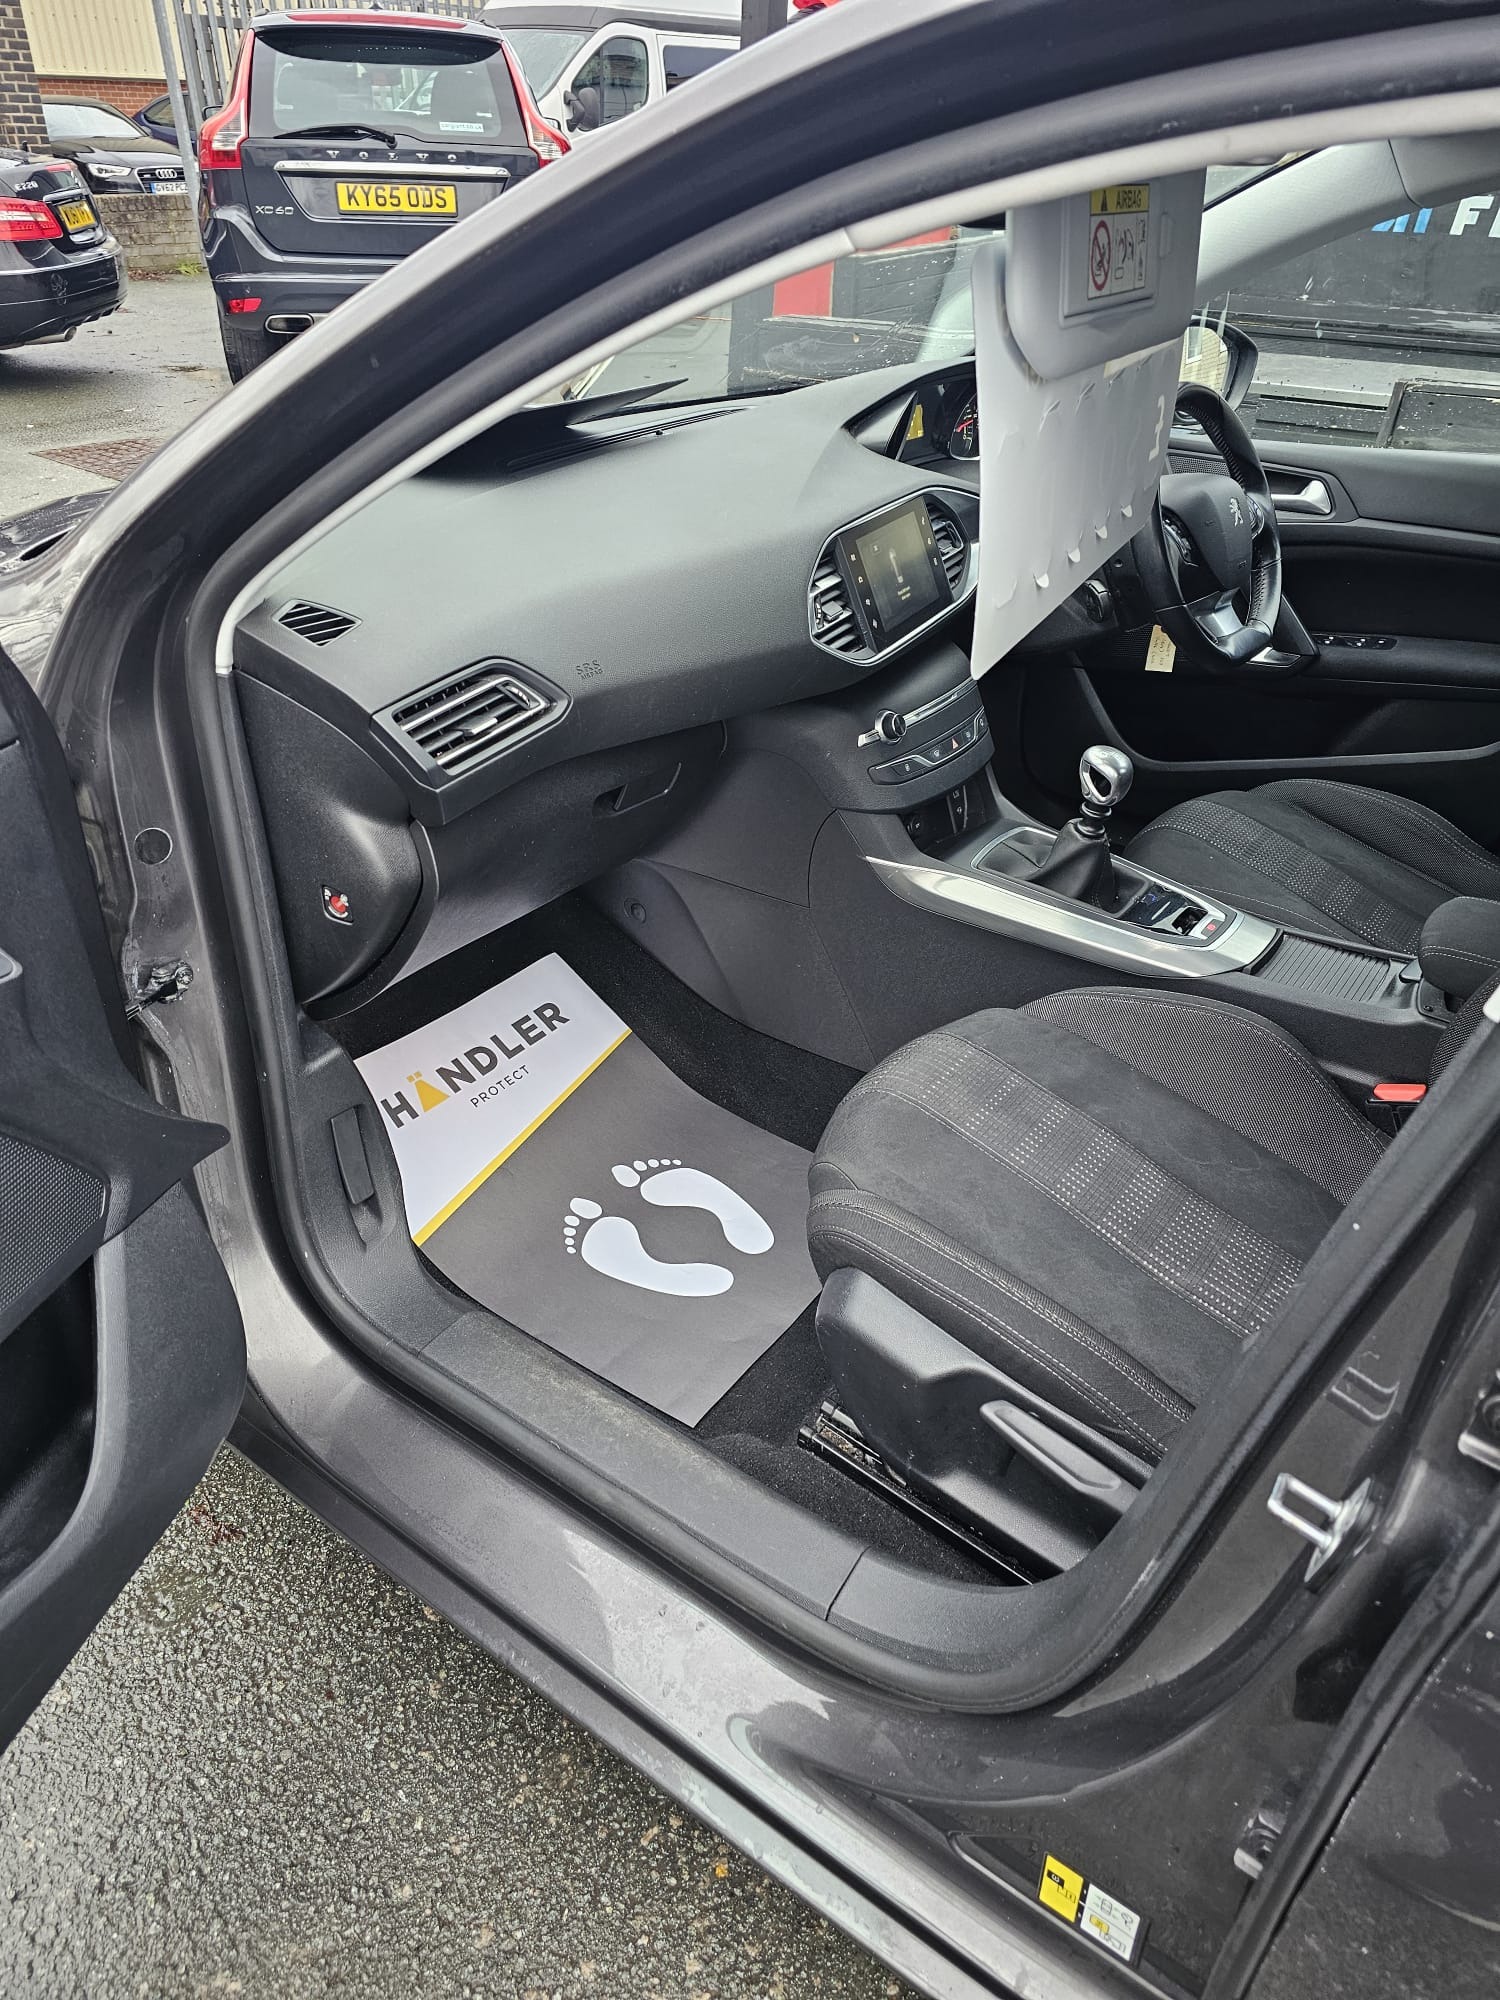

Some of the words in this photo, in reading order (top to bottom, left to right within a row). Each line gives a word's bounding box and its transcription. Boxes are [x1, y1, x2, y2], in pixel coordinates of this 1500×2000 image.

[326, 150, 457, 163] VOLVO
[346, 184, 401, 208] KY65
[407, 185, 448, 209] ODS
[1115, 189, 1142, 210] AIRBAG
[255, 205, 294, 215] XC60
[576, 659, 601, 675] SRS
[380, 1002, 571, 1129] HÄNDLER
[469, 1064, 530, 1108] PROTECT
